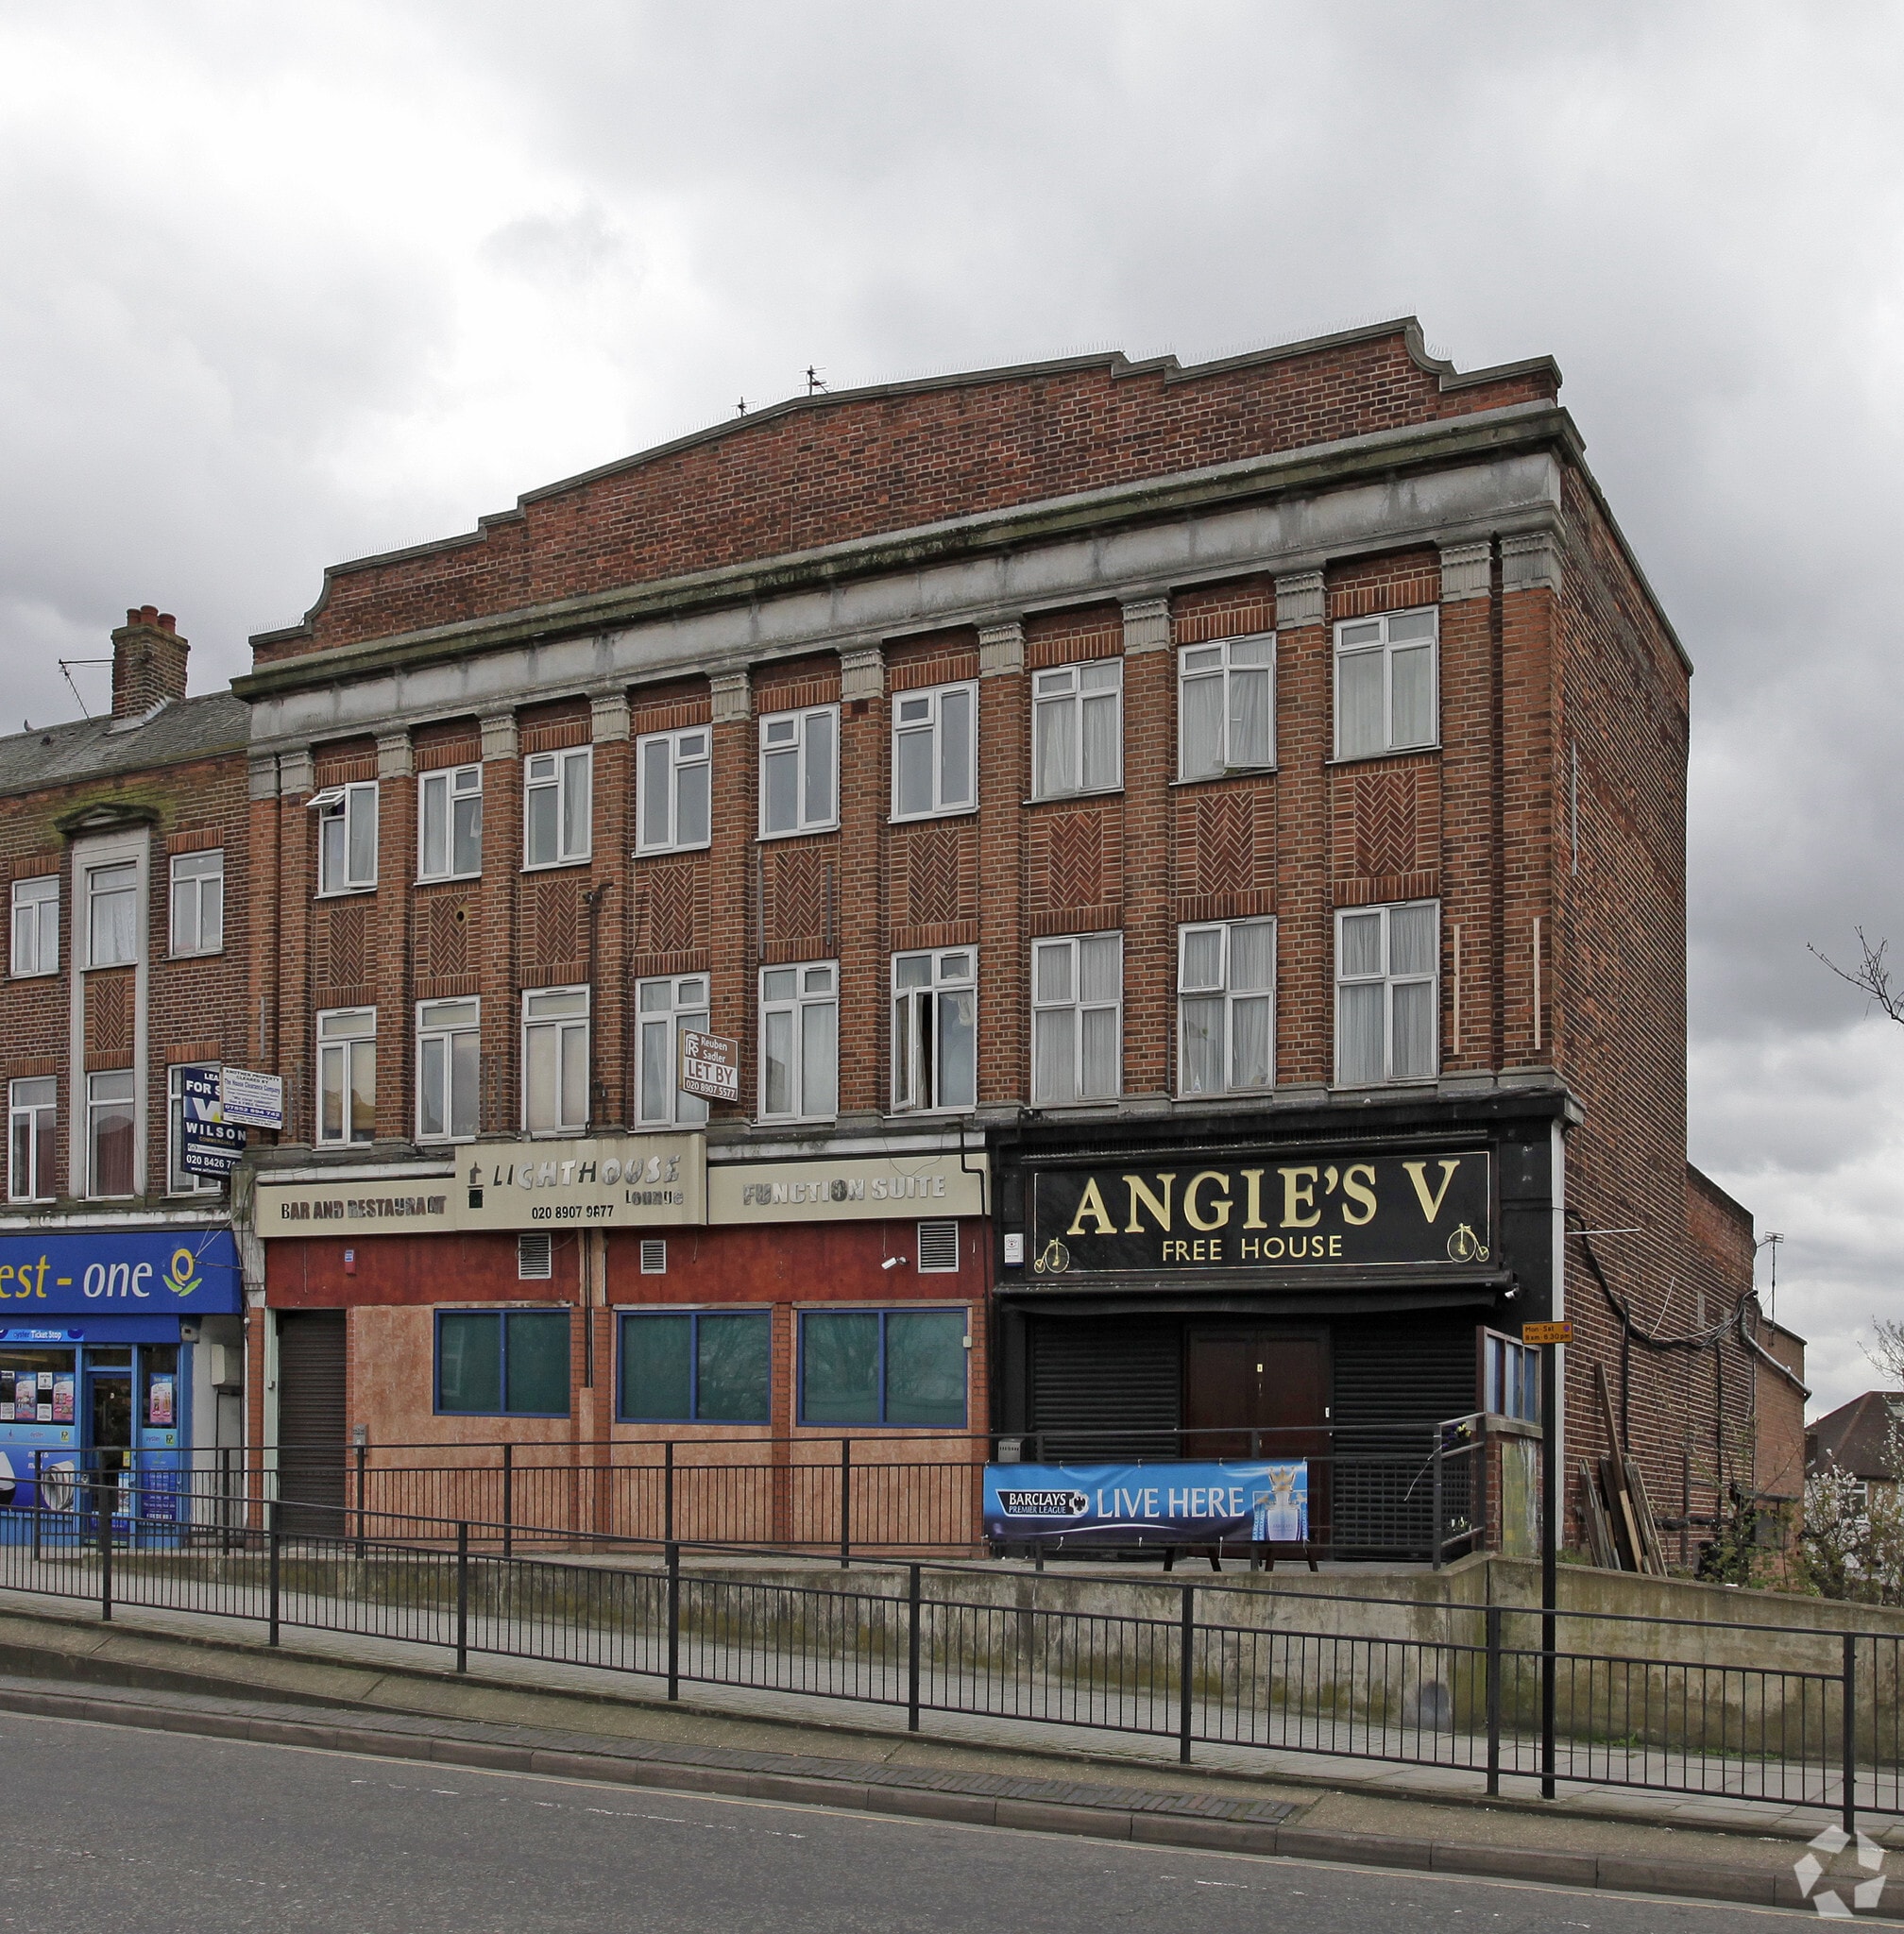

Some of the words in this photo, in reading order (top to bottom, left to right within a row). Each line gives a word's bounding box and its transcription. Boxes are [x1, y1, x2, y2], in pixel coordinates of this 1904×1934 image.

[701, 1036, 727, 1051] Reuben
[703, 1049, 725, 1063] Sadler
[252, 1073, 280, 1082] PROPERTY
[688, 1060, 711, 1080] LET
[716, 1065, 733, 1085] BY
[186, 1079, 212, 1094] FOR
[686, 1079, 700, 1091] 020
[700, 1082, 718, 1094] 8907
[719, 1087, 736, 1098] 5577
[186, 1122, 246, 1141] WILSON
[186, 1154, 202, 1166] 020
[204, 1157, 225, 1168] 8426
[743, 1179, 865, 1205] FUNCTION
[871, 1176, 945, 1200] SUITE
[1067, 1163, 1377, 1235] ANGIE'S
[1402, 1159, 1461, 1223] V
[281, 1202, 310, 1220] BAR
[314, 1200, 344, 1219] AND
[348, 1196, 447, 1218] RESTAURANT
[532, 1207, 552, 1220] 020
[555, 1206, 583, 1219] 8907
[1162, 1239, 1222, 1262] FREE
[1241, 1234, 1343, 1259] HOUSE
[83, 1262, 153, 1298] one
[1009, 1493, 1066, 1506] BARCLAYS
[1096, 1487, 1161, 1518] LIVE
[1168, 1487, 1245, 1518] HERE
[1009, 1505, 1038, 1514] PREMIER
[1039, 1505, 1066, 1514] LEAGUE
